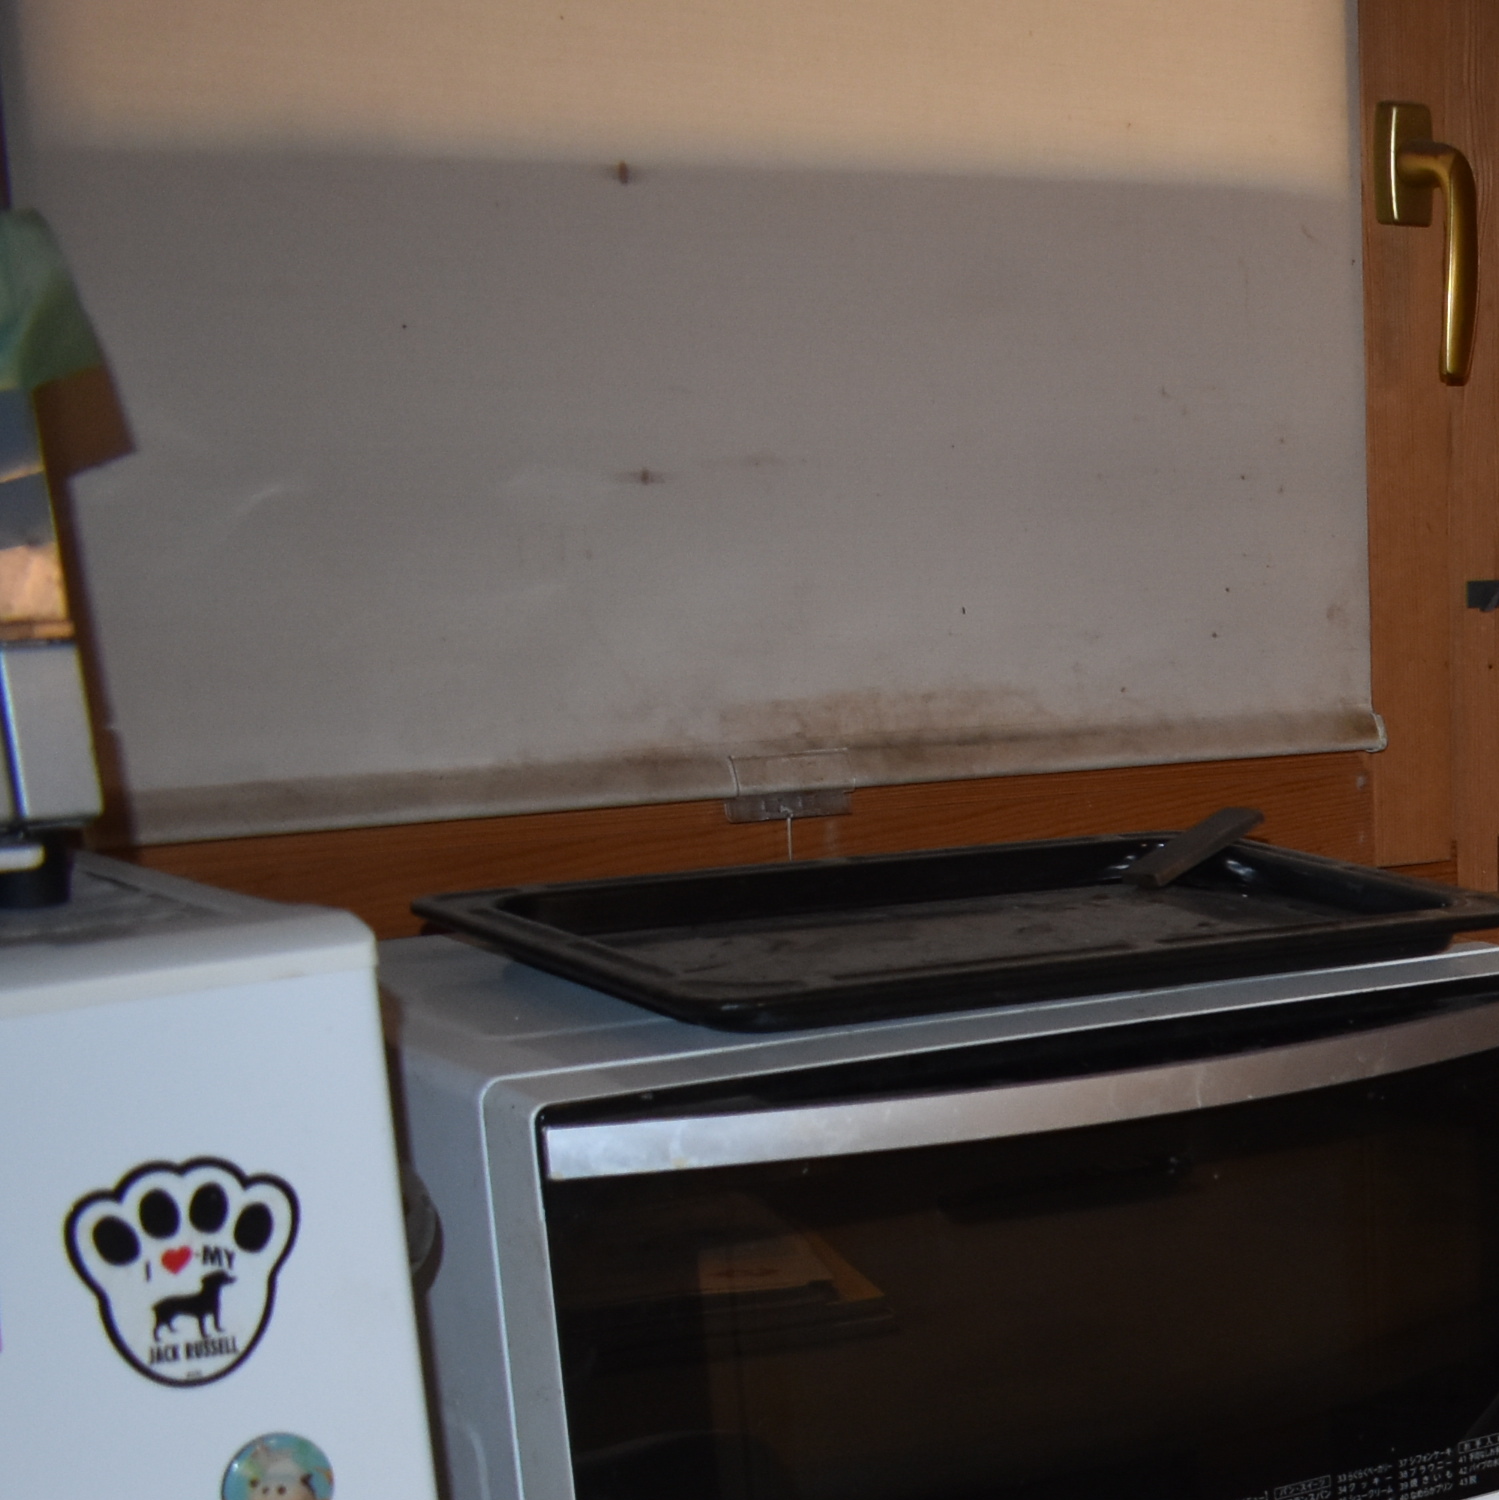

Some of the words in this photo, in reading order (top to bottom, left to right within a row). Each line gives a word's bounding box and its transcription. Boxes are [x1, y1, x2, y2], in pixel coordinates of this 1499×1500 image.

[145, 1260, 151, 1282] I
[202, 1245, 235, 1269] MY
[149, 1344, 180, 1364] JACK
[186, 1336, 239, 1360] RUSSELL
